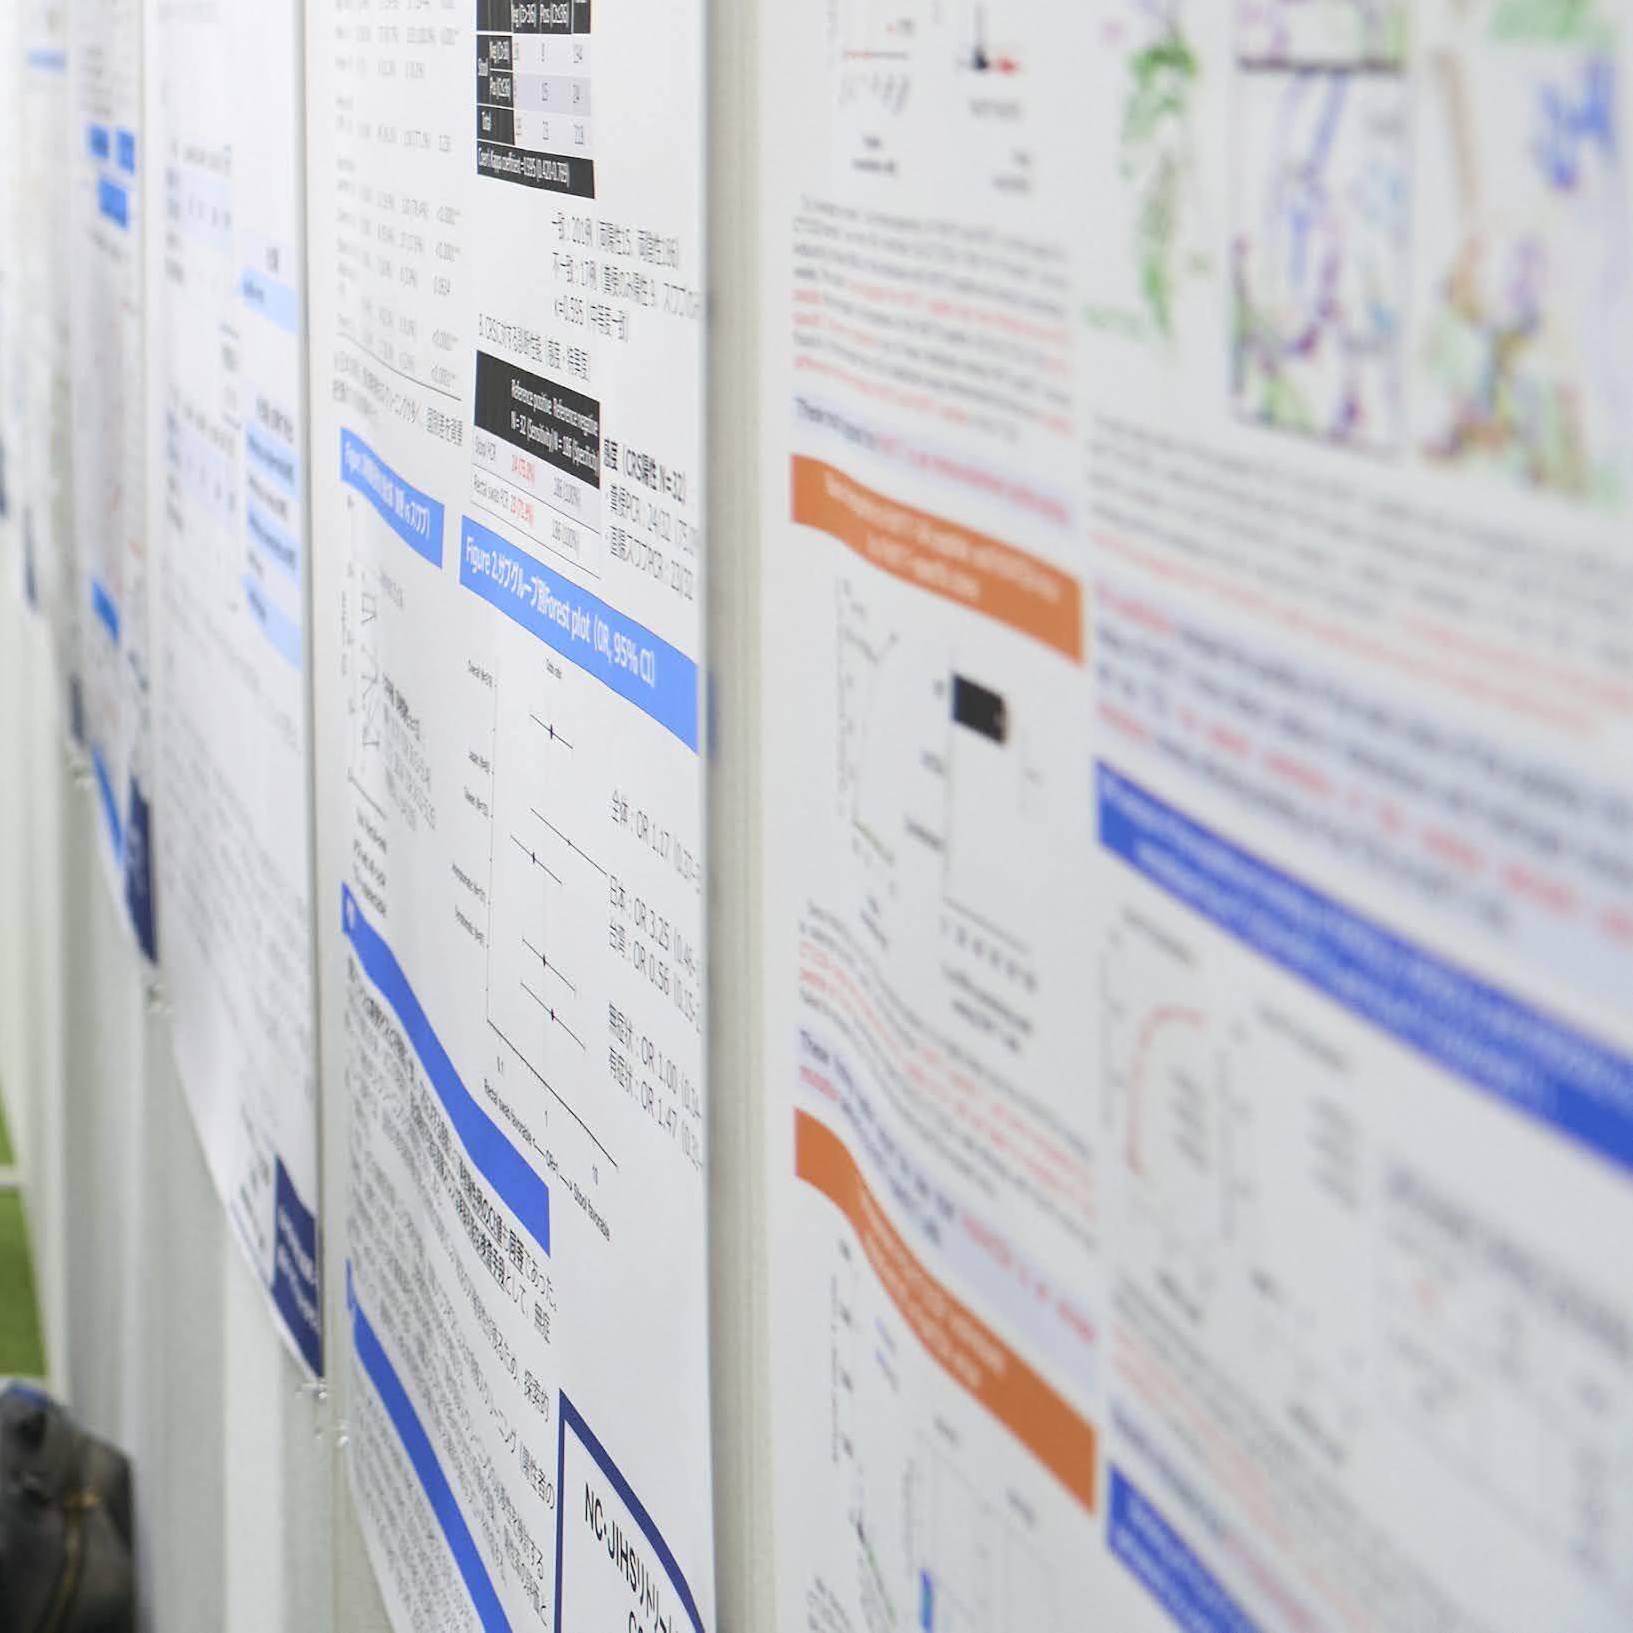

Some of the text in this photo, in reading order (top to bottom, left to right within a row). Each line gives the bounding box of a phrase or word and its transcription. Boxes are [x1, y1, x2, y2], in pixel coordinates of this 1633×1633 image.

[465, 535, 490, 575] Figure
[571, 604, 591, 645] plot
[613, 629, 638, 674] 95%
